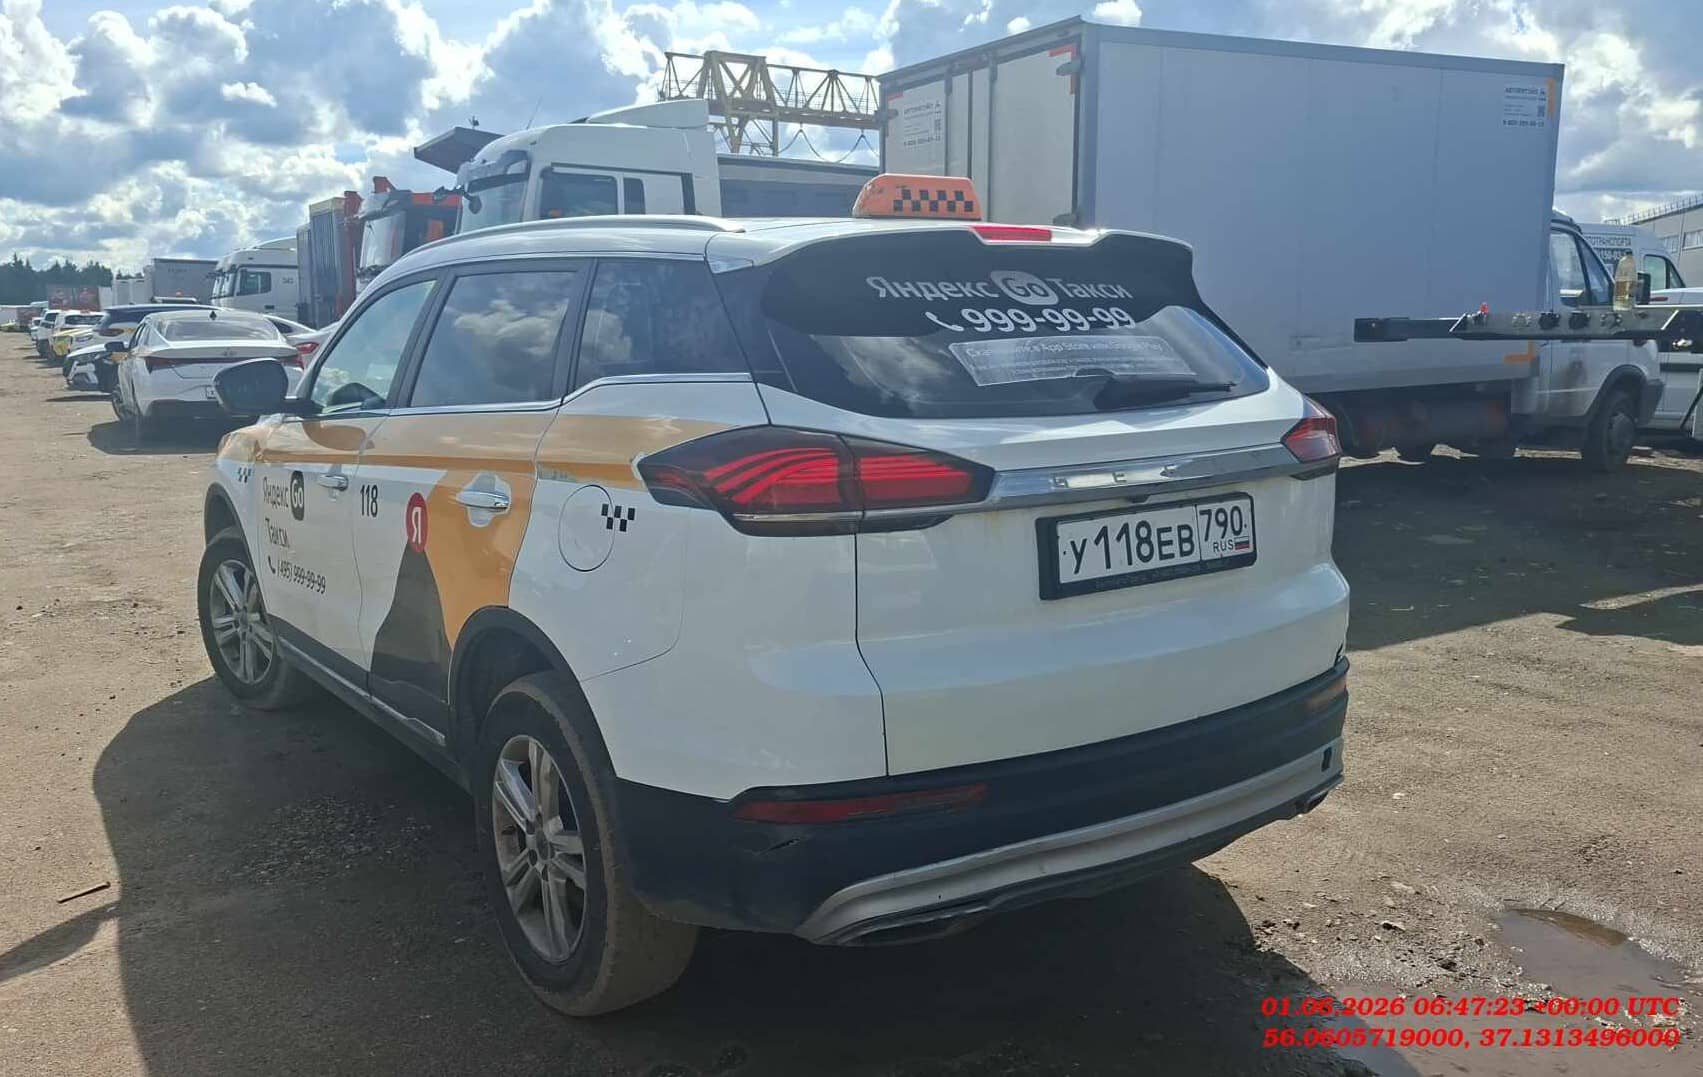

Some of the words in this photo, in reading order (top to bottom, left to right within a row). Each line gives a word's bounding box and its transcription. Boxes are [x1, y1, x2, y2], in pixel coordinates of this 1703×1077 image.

[866, 276, 1000, 301] Яндекс
[1046, 278, 1133, 299] Такси
[961, 307, 1136, 333] 999-99-99
[263, 476, 289, 509] Яндекс
[360, 484, 378, 517] 118
[412, 506, 421, 544] Я
[1200, 506, 1242, 541] 790
[1213, 540, 1234, 553] RUS
[293, 565, 326, 593] 999-99-99
